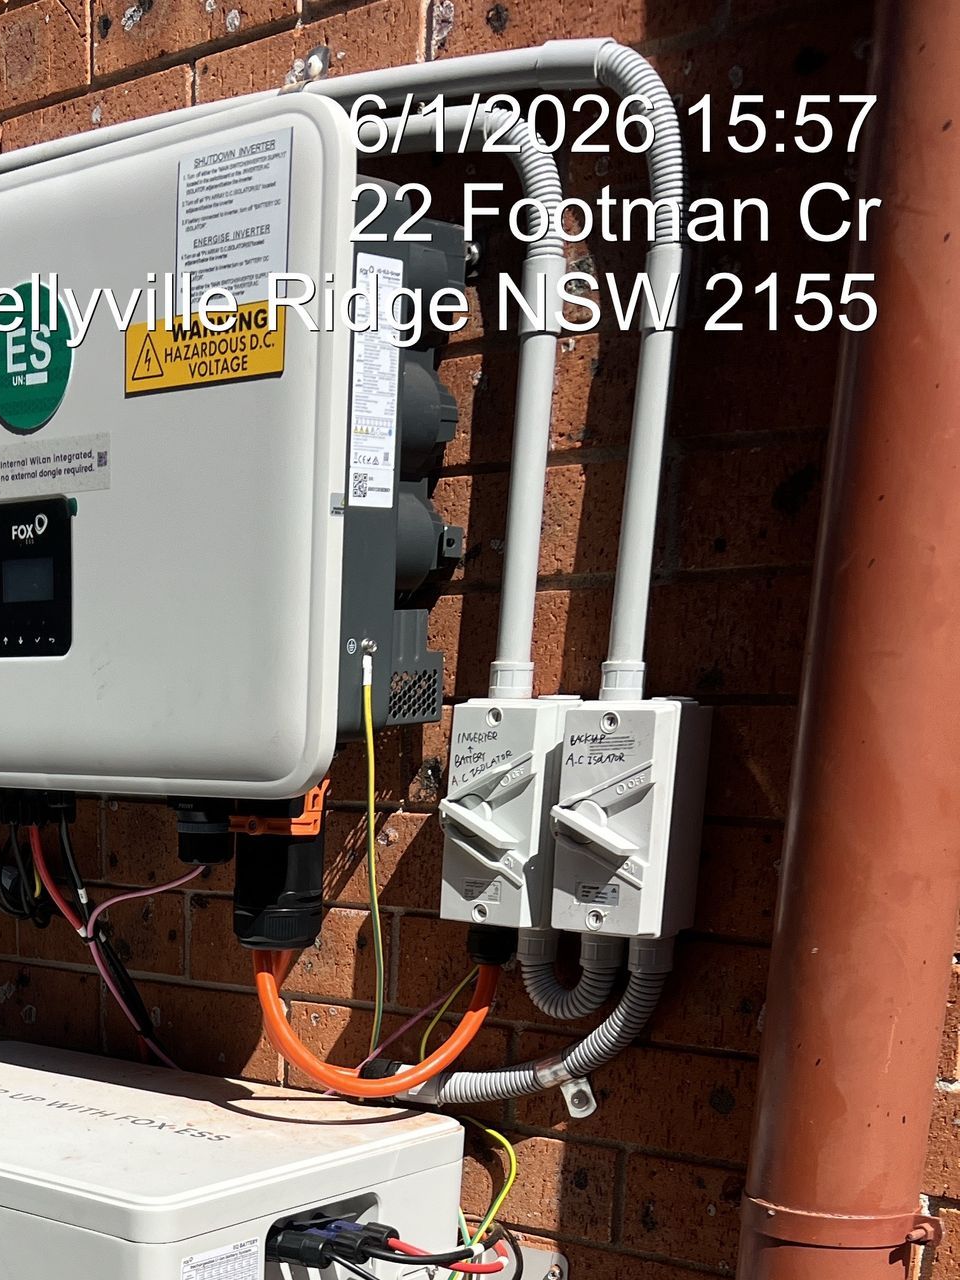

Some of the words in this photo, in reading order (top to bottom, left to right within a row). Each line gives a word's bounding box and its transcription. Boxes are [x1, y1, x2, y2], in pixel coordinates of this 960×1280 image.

[194, 149, 235, 168] SHUTDOWN
[239, 139, 275, 157] INVERTER
[193, 232, 230, 249] ENERGISE
[233, 224, 271, 239] INVERTER
[6, 324, 52, 374] ES
[164, 334, 246, 364] HAZARDOUS
[249, 331, 275, 350] D.C.
[189, 355, 248, 378] VOLTAGE
[0, 457, 28, 469] Internal
[0, 474, 10, 482] no
[11, 468, 38, 481] external
[39, 465, 62, 479] dongle
[64, 464, 95, 478] required.
[12, 524, 34, 540] FOX
[457, 731, 498, 744] INVERTER
[570, 733, 606, 746] BACKUP
[454, 752, 486, 767] BATTERY
[470, 750, 512, 778] ISOLATOR
[627, 774, 646, 788] OFF
[623, 861, 637, 874] ON
[9, 1092, 46, 1103] UP
[46, 1100, 116, 1118] WITH
[115, 1114, 171, 1131] FOX
[174, 1126, 231, 1142] ESS
[240, 1239, 258, 1248] BATTERY
